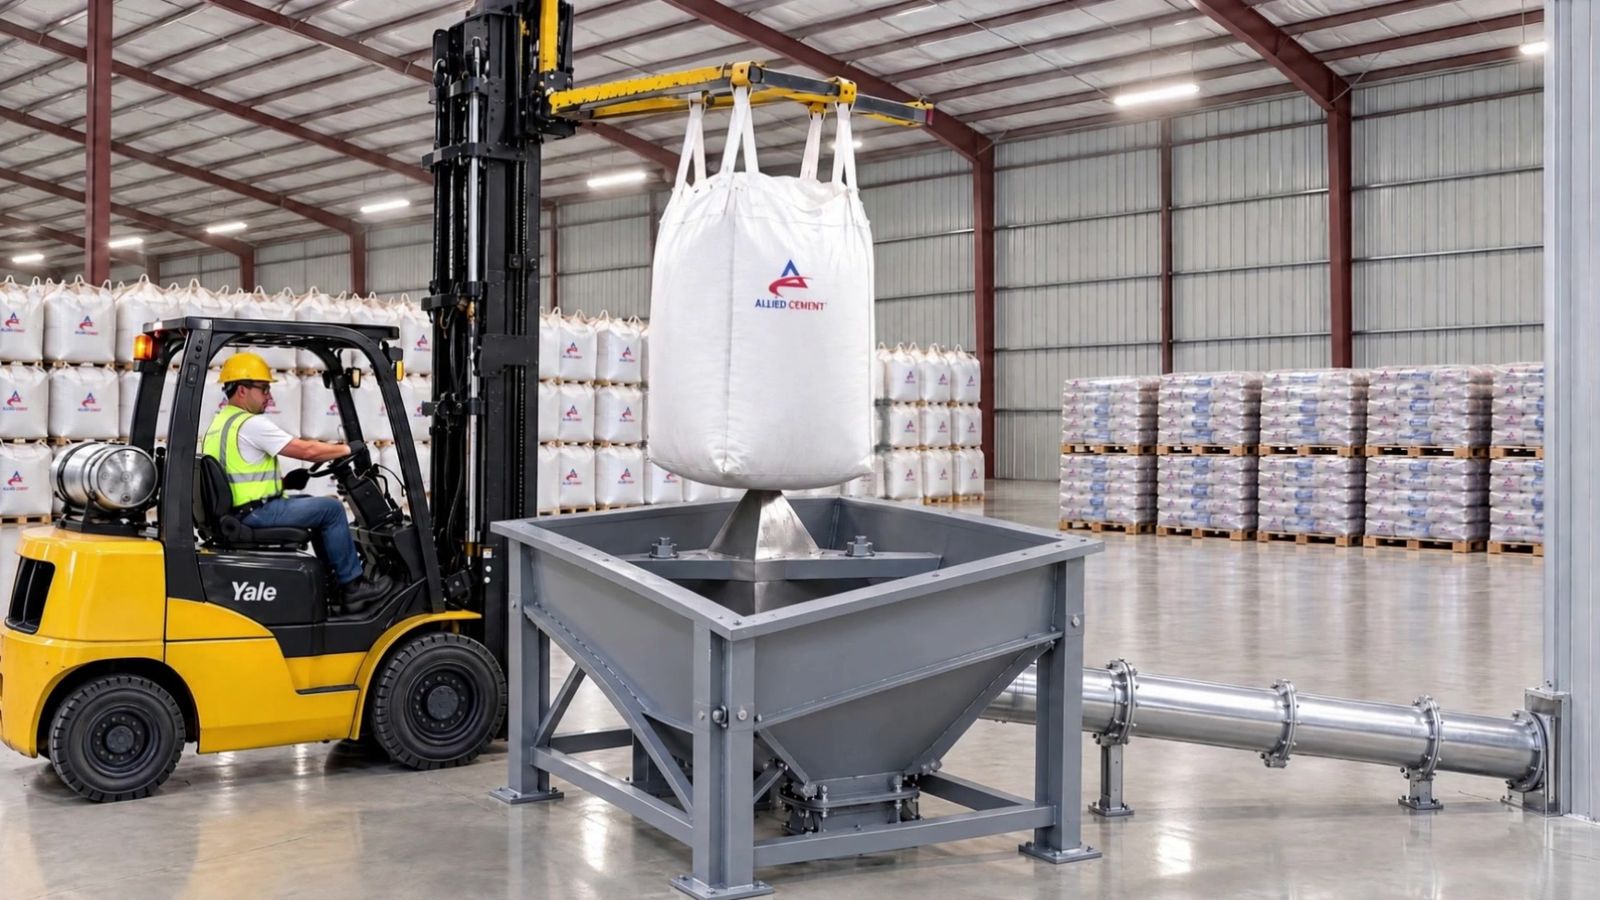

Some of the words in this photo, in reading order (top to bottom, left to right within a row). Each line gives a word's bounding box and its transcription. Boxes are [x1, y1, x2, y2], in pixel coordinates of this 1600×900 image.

[755, 299, 787, 309] ALLIED
[788, 300, 825, 311] CEMENT
[231, 581, 277, 602] Yale
